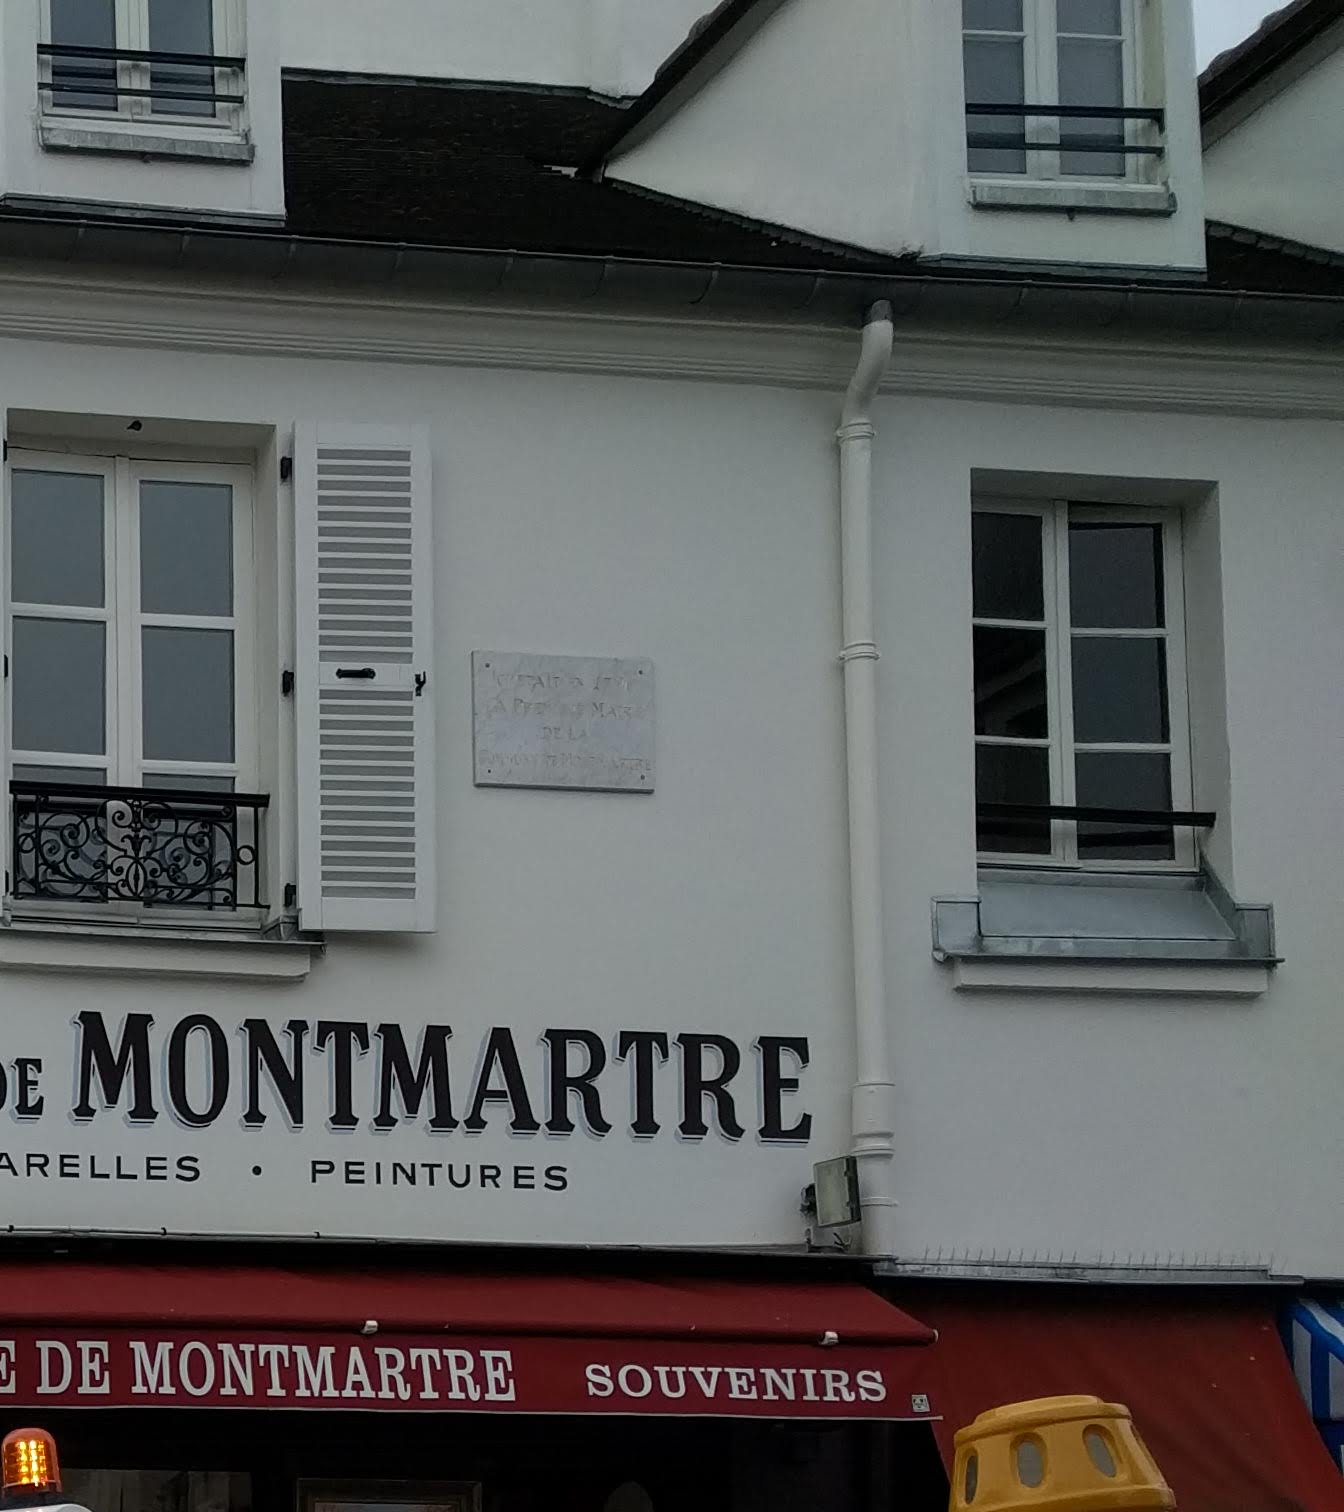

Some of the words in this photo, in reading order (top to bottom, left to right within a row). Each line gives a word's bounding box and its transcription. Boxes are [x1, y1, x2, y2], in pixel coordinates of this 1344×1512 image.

[69, 1009, 814, 1145] MONTMARTRE
[310, 1159, 569, 1192] PEINTURES
[35, 1340, 111, 1395] DE
[128, 1340, 517, 1402] MONTMARTRE
[584, 1363, 888, 1404] SOUVENIRS
